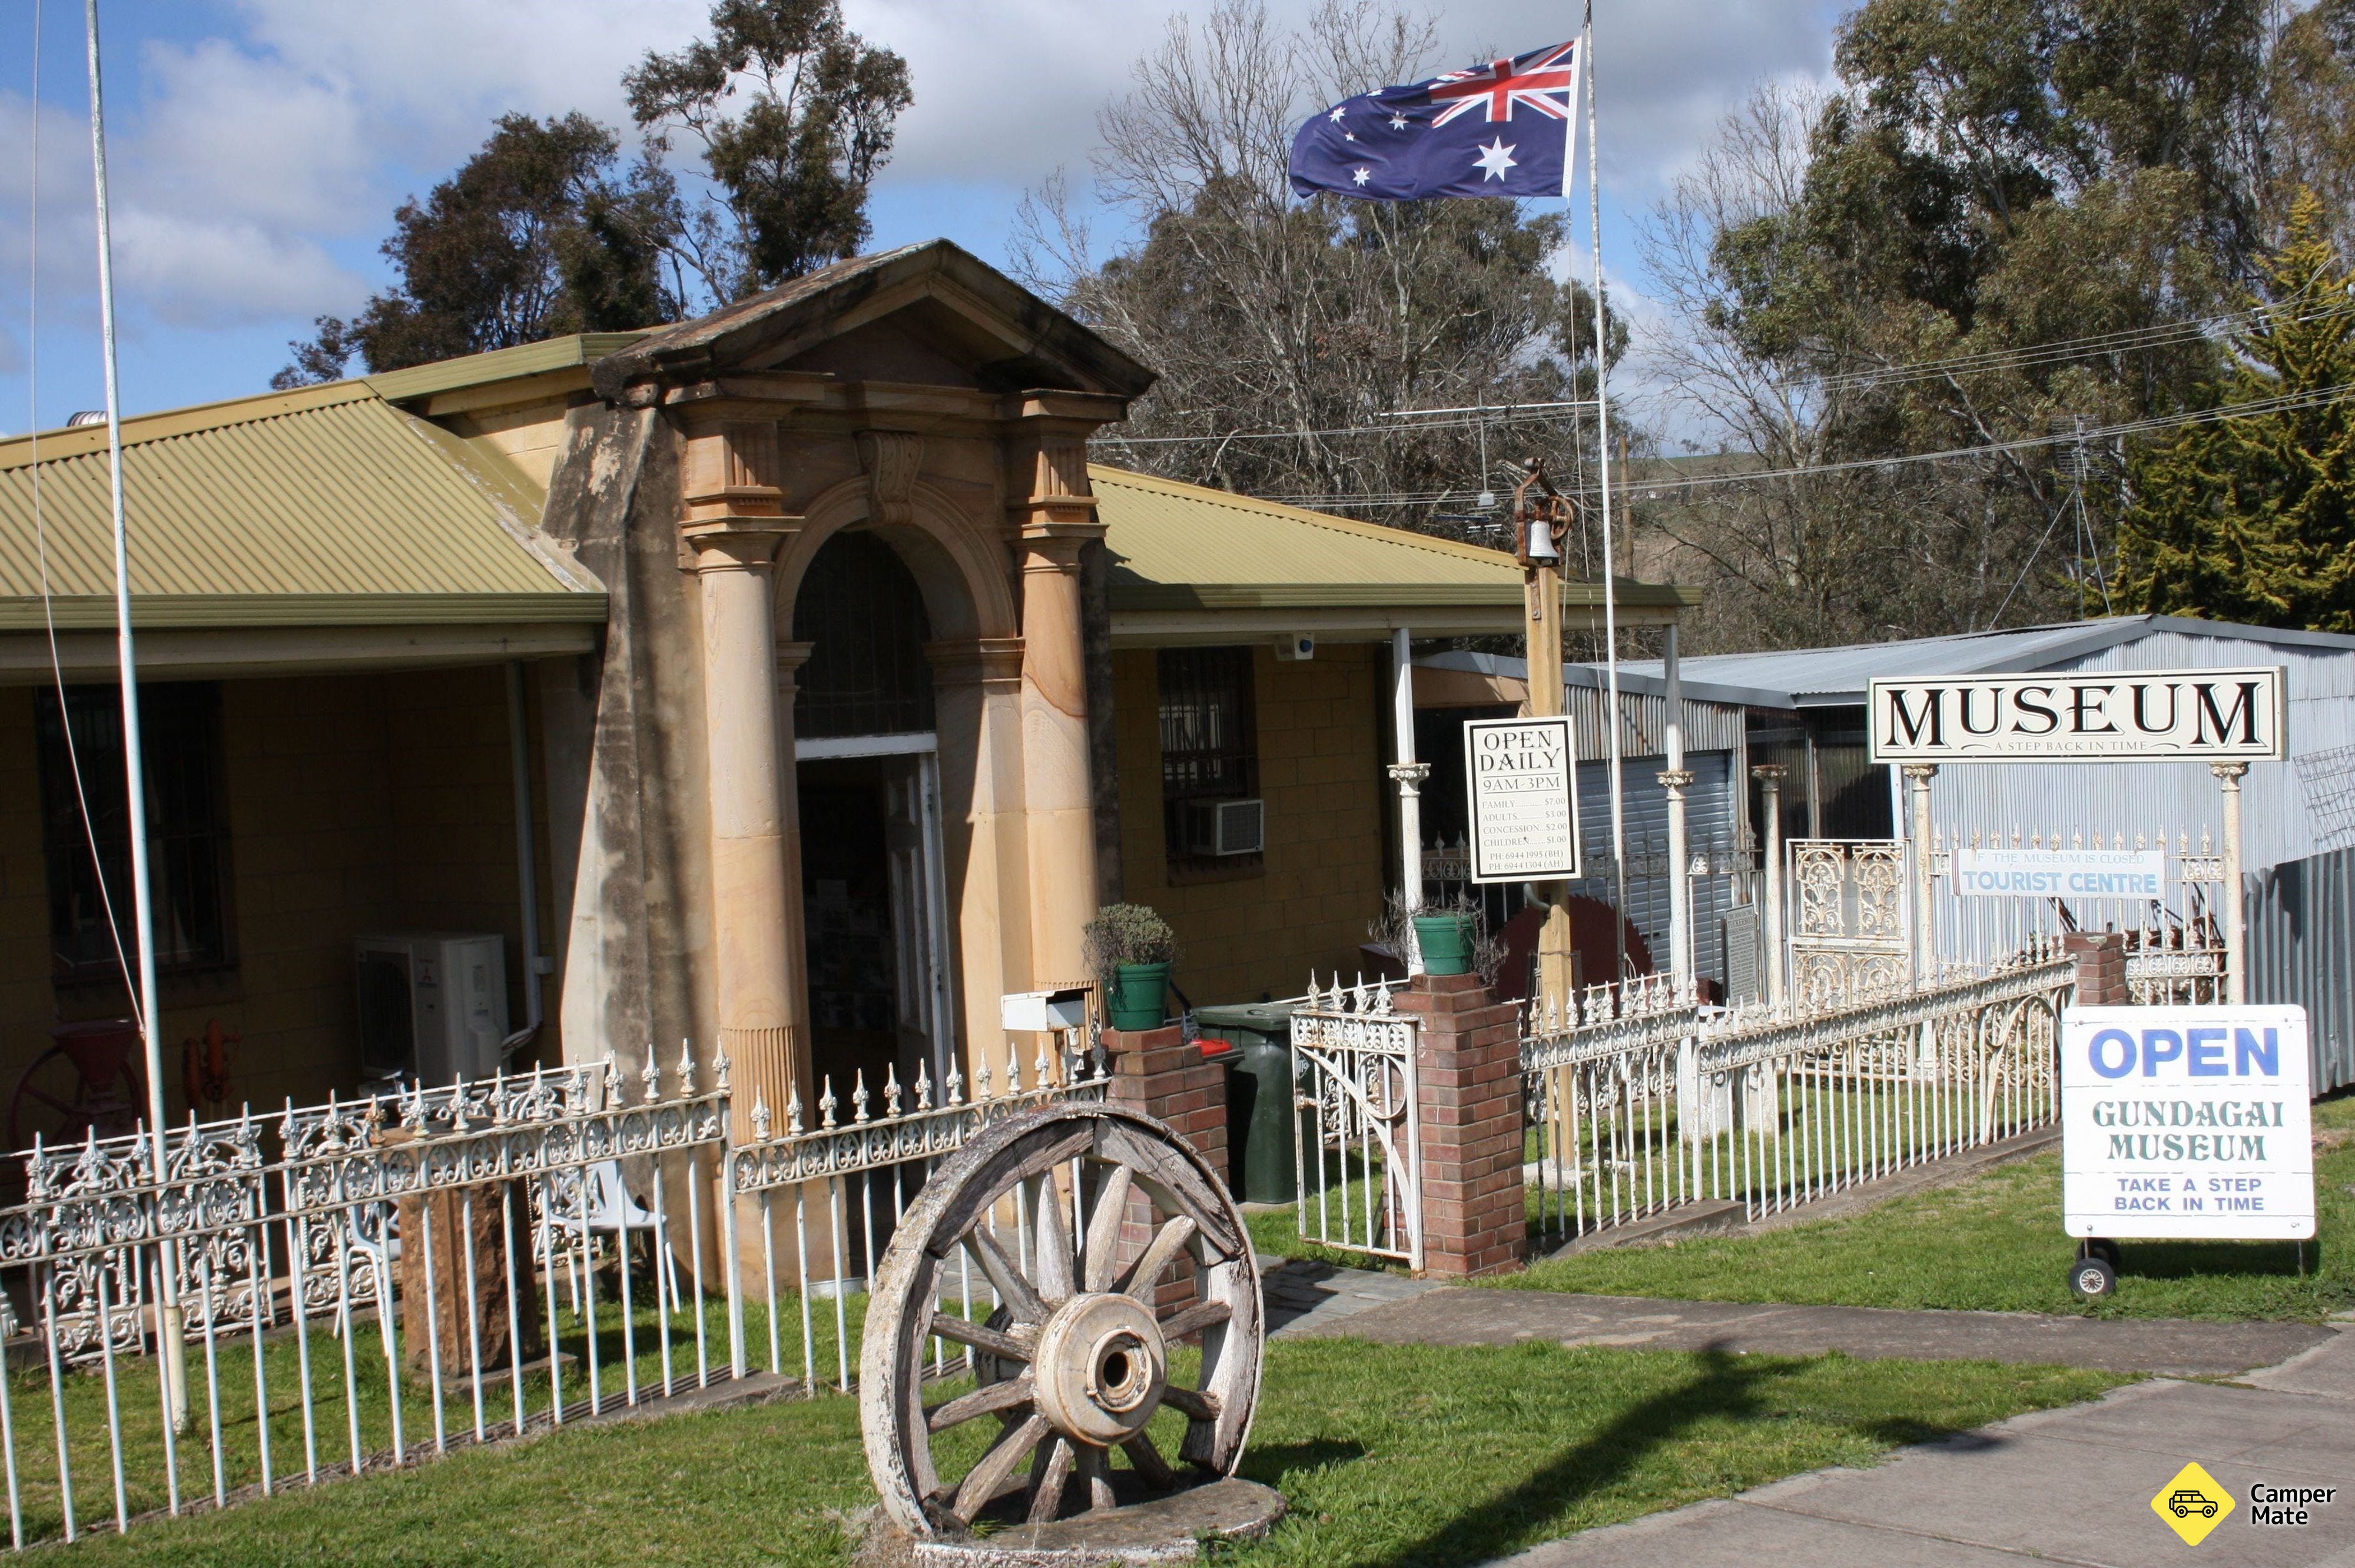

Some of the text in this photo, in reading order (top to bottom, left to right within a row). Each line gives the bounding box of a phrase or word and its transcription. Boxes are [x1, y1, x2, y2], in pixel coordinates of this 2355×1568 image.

[1882, 682, 2268, 749] MUSEUM
[1484, 730, 1552, 750] OPEN
[1995, 741, 2147, 750] A STEP BACK IN TIME
[1480, 747, 1562, 772] DAILY
[1545, 798, 1565, 806] $7.00
[1545, 810, 1566, 818] $3.00
[1547, 835, 1566, 844] $1.00
[1973, 853, 2144, 864] IF THE MUSEUM IS CLOSED
[1963, 871, 2157, 893] TOURIST CENTRE
[2088, 1028, 2278, 1079] OPEN
[2092, 1101, 2284, 1127] GUNDAGAI
[2108, 1134, 2267, 1161] MUSEUM
[2118, 1178, 2261, 1192] TAKE A STEP
[2115, 1197, 2264, 1211] BACK IN TIME
